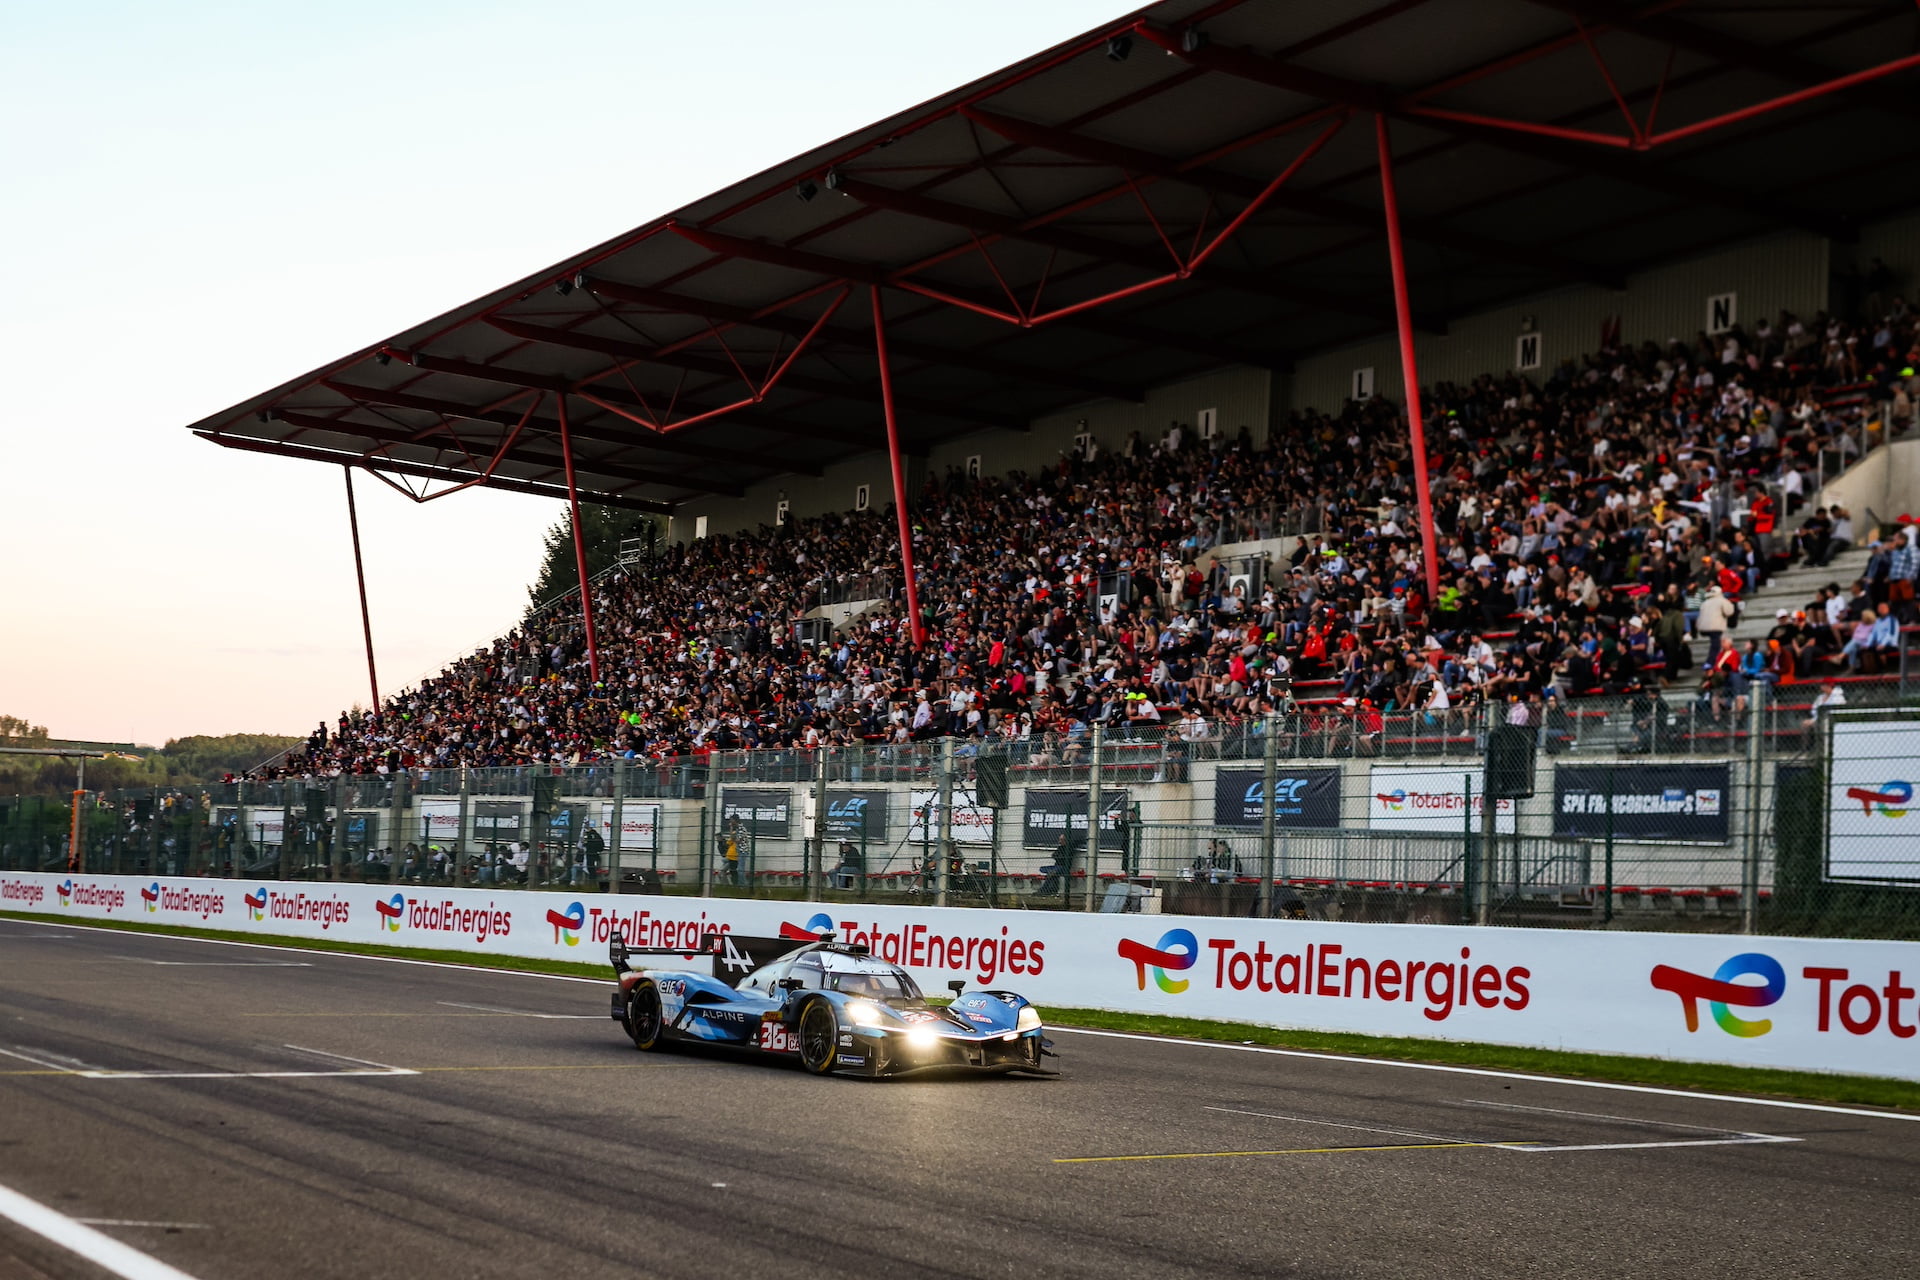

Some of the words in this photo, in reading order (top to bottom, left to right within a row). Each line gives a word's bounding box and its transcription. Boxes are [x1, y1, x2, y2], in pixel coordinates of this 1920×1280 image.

[1714, 297, 1729, 330] N
[1522, 337, 1536, 366] M
[1357, 372, 1367, 398] L
[969, 457, 978, 480] G
[858, 487, 867, 509] D
[1561, 794, 1587, 814] SPA
[1587, 794, 1694, 815] FRNCORCHAMPS
[73, 883, 125, 913] TotalEnergies
[161, 886, 225, 921] TotalEnergies
[269, 892, 350, 931] TotalEnergies
[407, 898, 513, 944] TotalEnergies
[1208, 938, 1531, 1022] TotalEnergies
[702, 1010, 745, 1022] ALPINE
[1803, 967, 1920, 1039] Tot
[761, 1021, 787, 1050] 36
